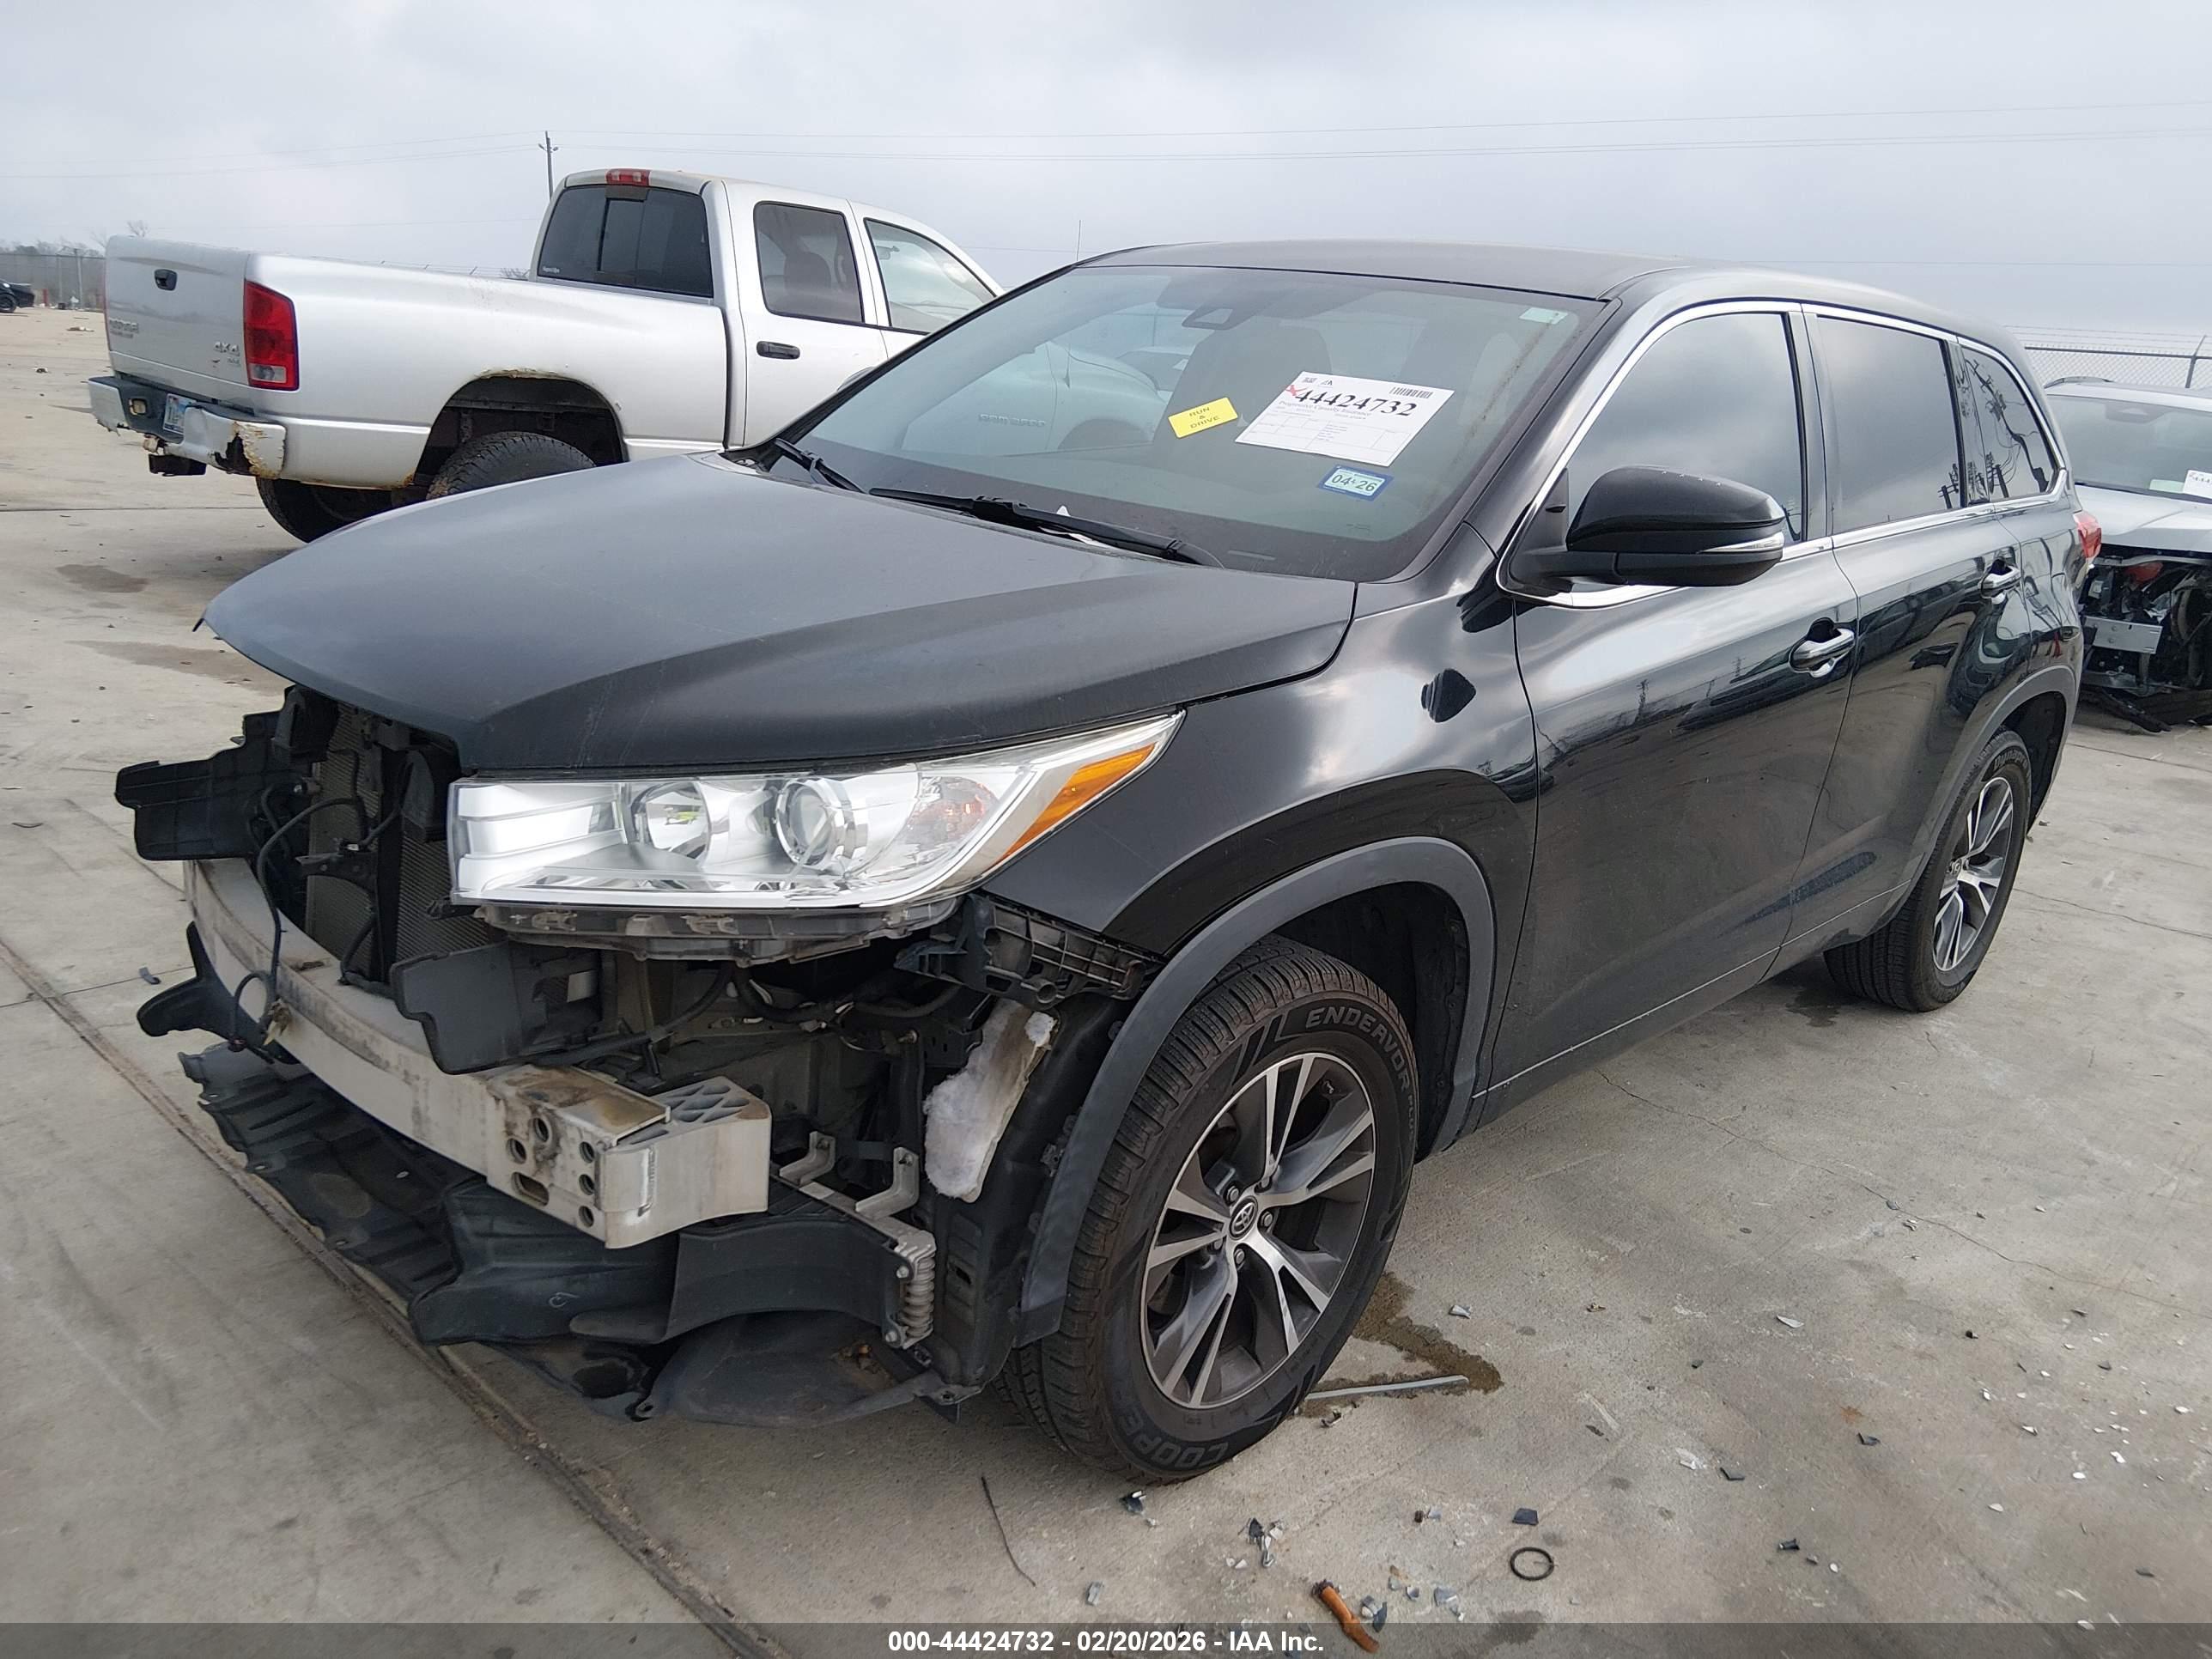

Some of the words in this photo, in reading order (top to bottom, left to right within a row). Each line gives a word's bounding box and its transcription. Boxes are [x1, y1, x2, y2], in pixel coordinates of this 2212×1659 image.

[1188, 406, 1210, 417] RUN
[1295, 390, 1417, 416] 44424732
[1190, 419, 1220, 428] DRIVE
[1305, 1006, 1410, 1092] ENDEAVOR
[1116, 1405, 1229, 1468] COOPE
